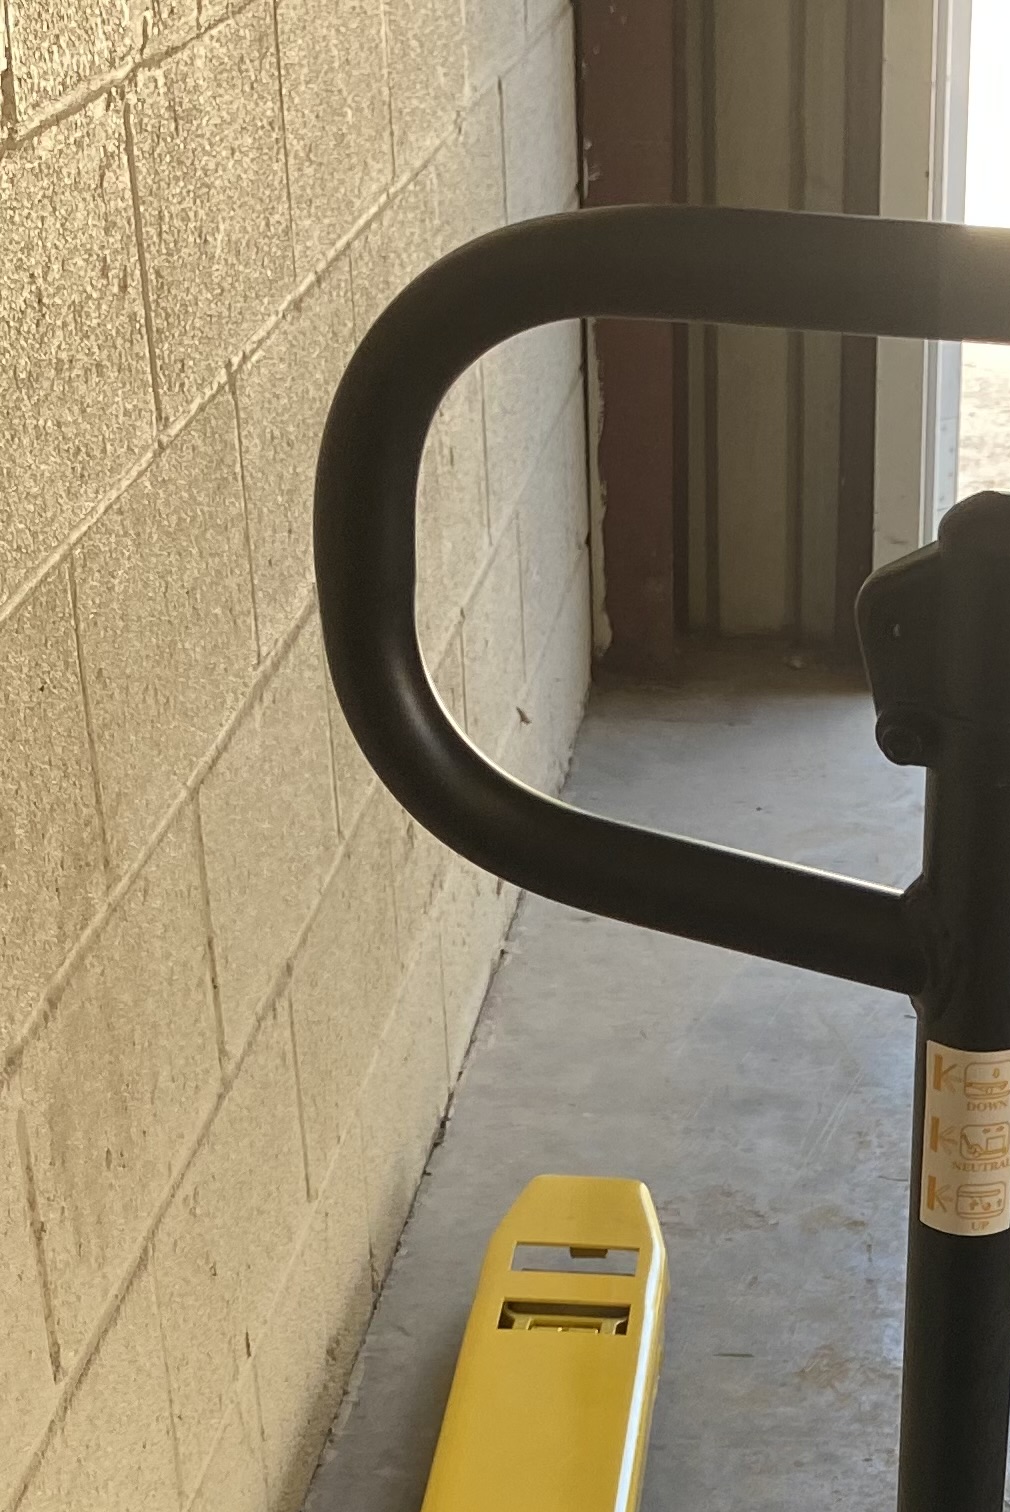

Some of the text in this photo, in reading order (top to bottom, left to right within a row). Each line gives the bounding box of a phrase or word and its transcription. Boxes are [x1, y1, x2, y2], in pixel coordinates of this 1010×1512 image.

[967, 1100, 1008, 1112] DOWN
[953, 1160, 1010, 1172] NEUTRAL
[971, 1220, 990, 1231] UP
